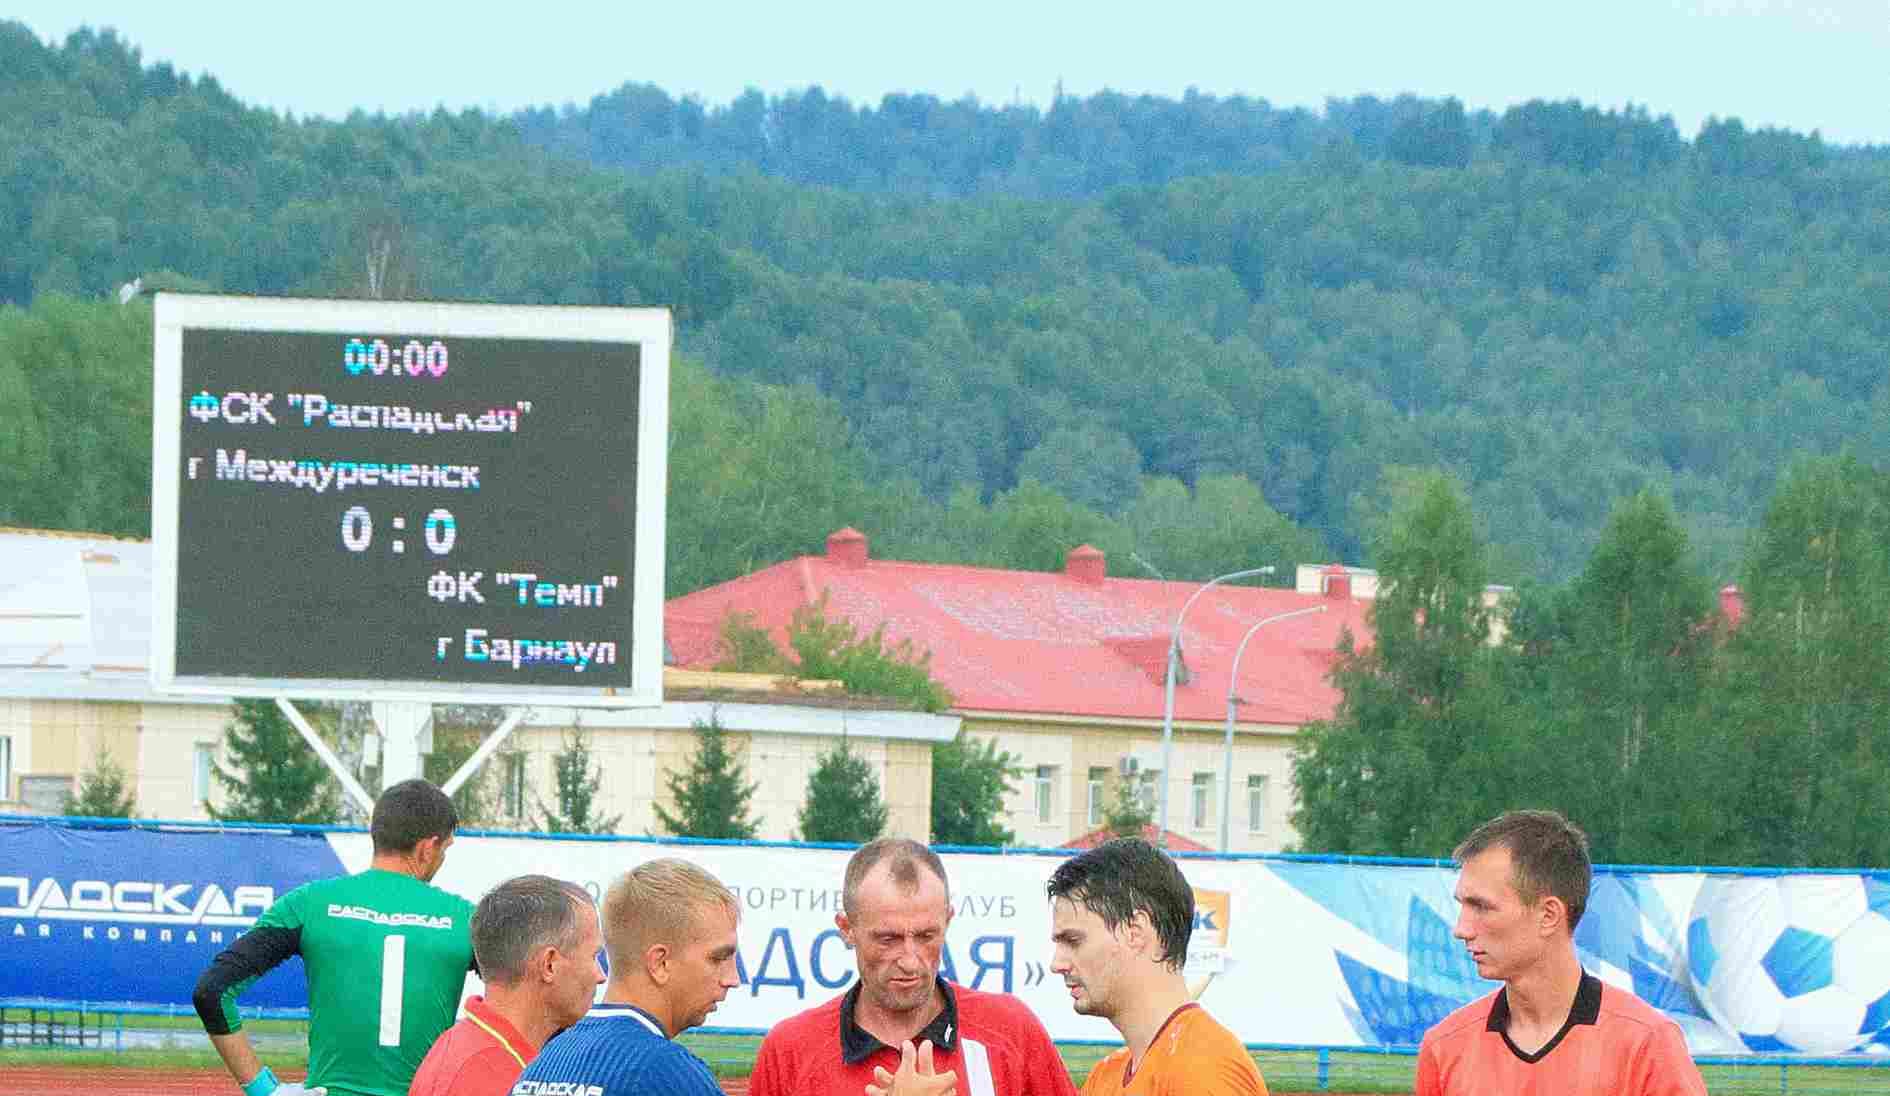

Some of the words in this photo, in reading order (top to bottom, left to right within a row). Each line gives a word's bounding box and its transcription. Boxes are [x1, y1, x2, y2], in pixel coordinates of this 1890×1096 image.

[344, 338, 449, 377] 00:00
[189, 389, 276, 425] ФСК
[186, 456, 203, 481] г
[215, 448, 480, 492] Междуреченск
[426, 570, 486, 603] ФК
[495, 572, 619, 608] "Темп"
[438, 636, 454, 662] г
[464, 628, 617, 672] Барнаул
[960, 893, 1017, 918] ЛУБ
[379, 934, 406, 1047] 1
